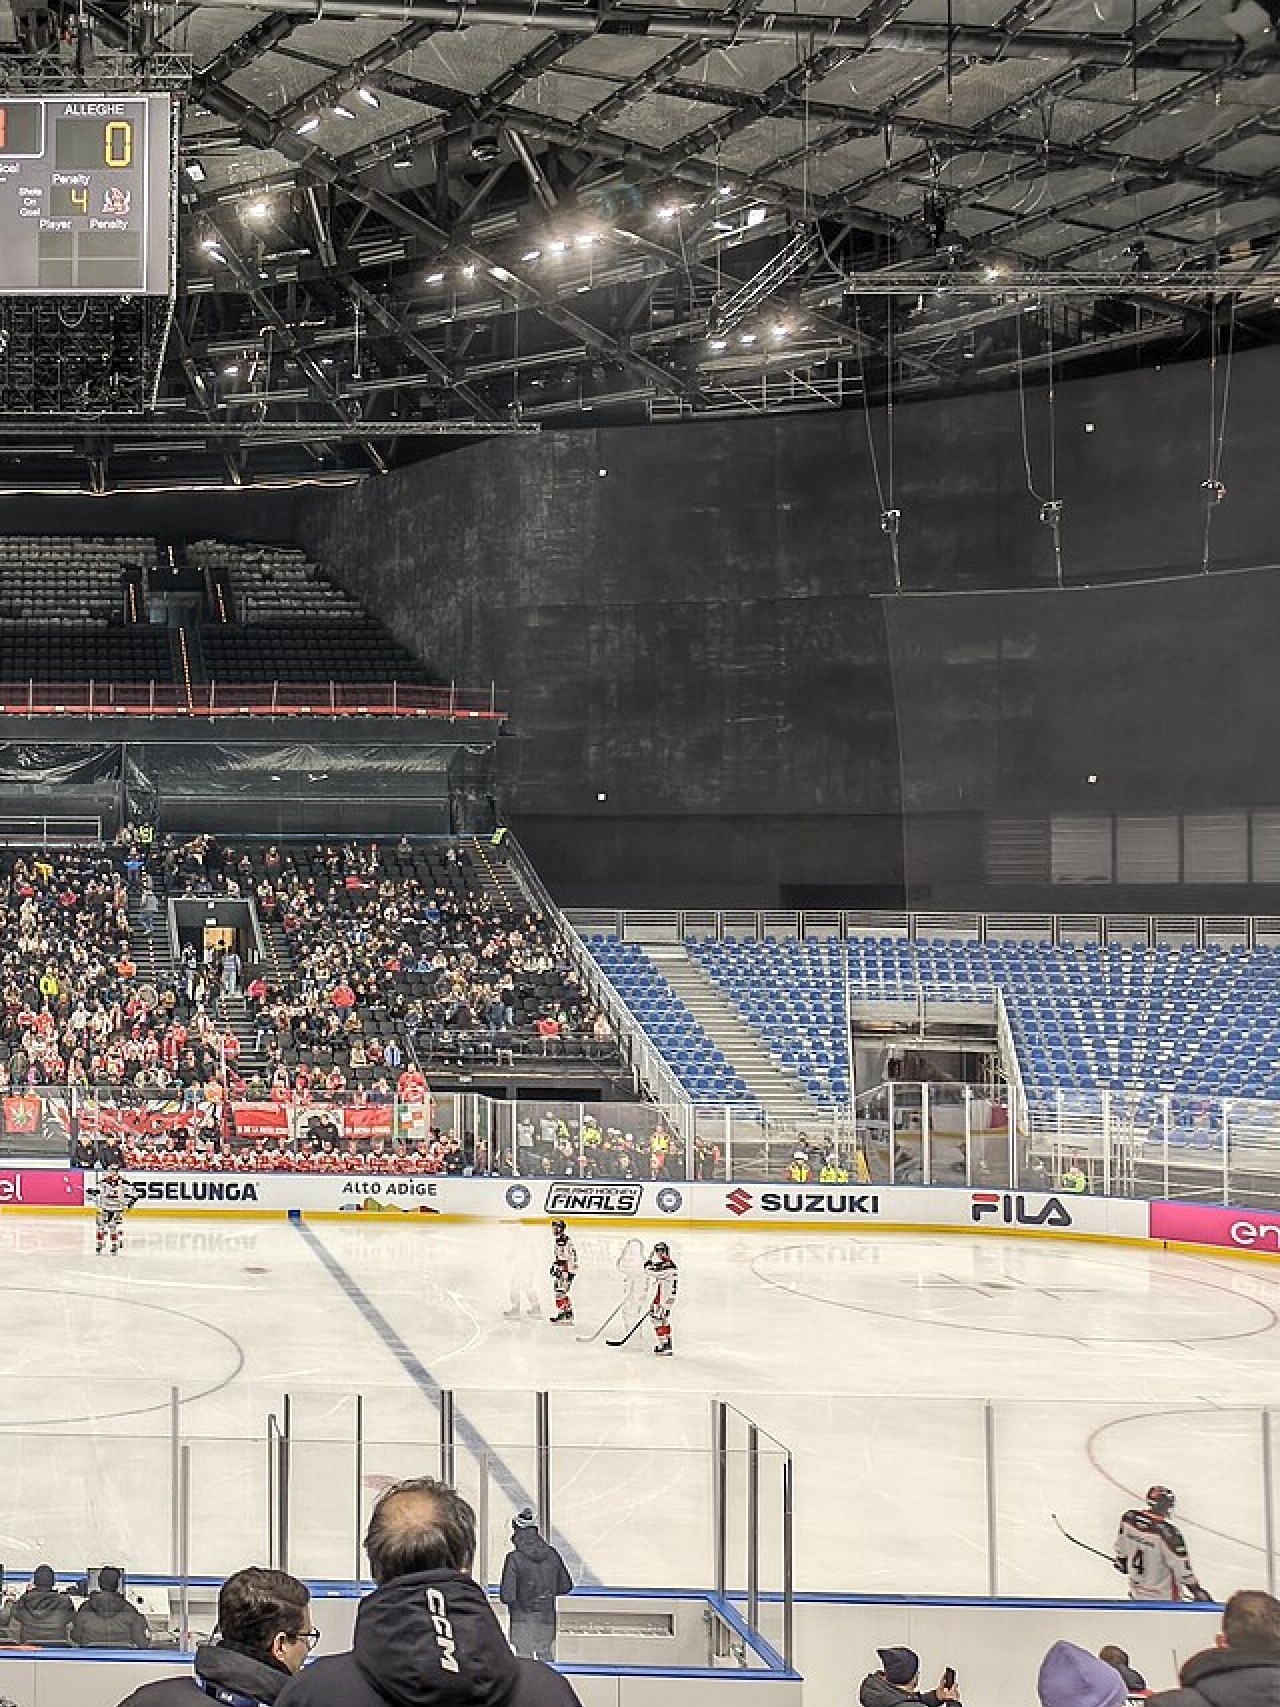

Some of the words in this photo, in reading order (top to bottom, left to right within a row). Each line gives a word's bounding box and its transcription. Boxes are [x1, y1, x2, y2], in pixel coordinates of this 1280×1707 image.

[64, 103, 125, 115] ALLEGHE
[104, 121, 132, 167] 0
[53, 173, 90, 186] Penalty
[70, 188, 88, 212] 4
[39, 218, 72, 231] Player
[89, 218, 129, 231] Penalty
[132, 1181, 257, 1200] SSELUNGA
[551, 1195, 634, 1210] FINALS
[761, 1193, 879, 1213] SUZUKI
[971, 1193, 1072, 1226] FILA
[426, 1588, 460, 1673] CCM
